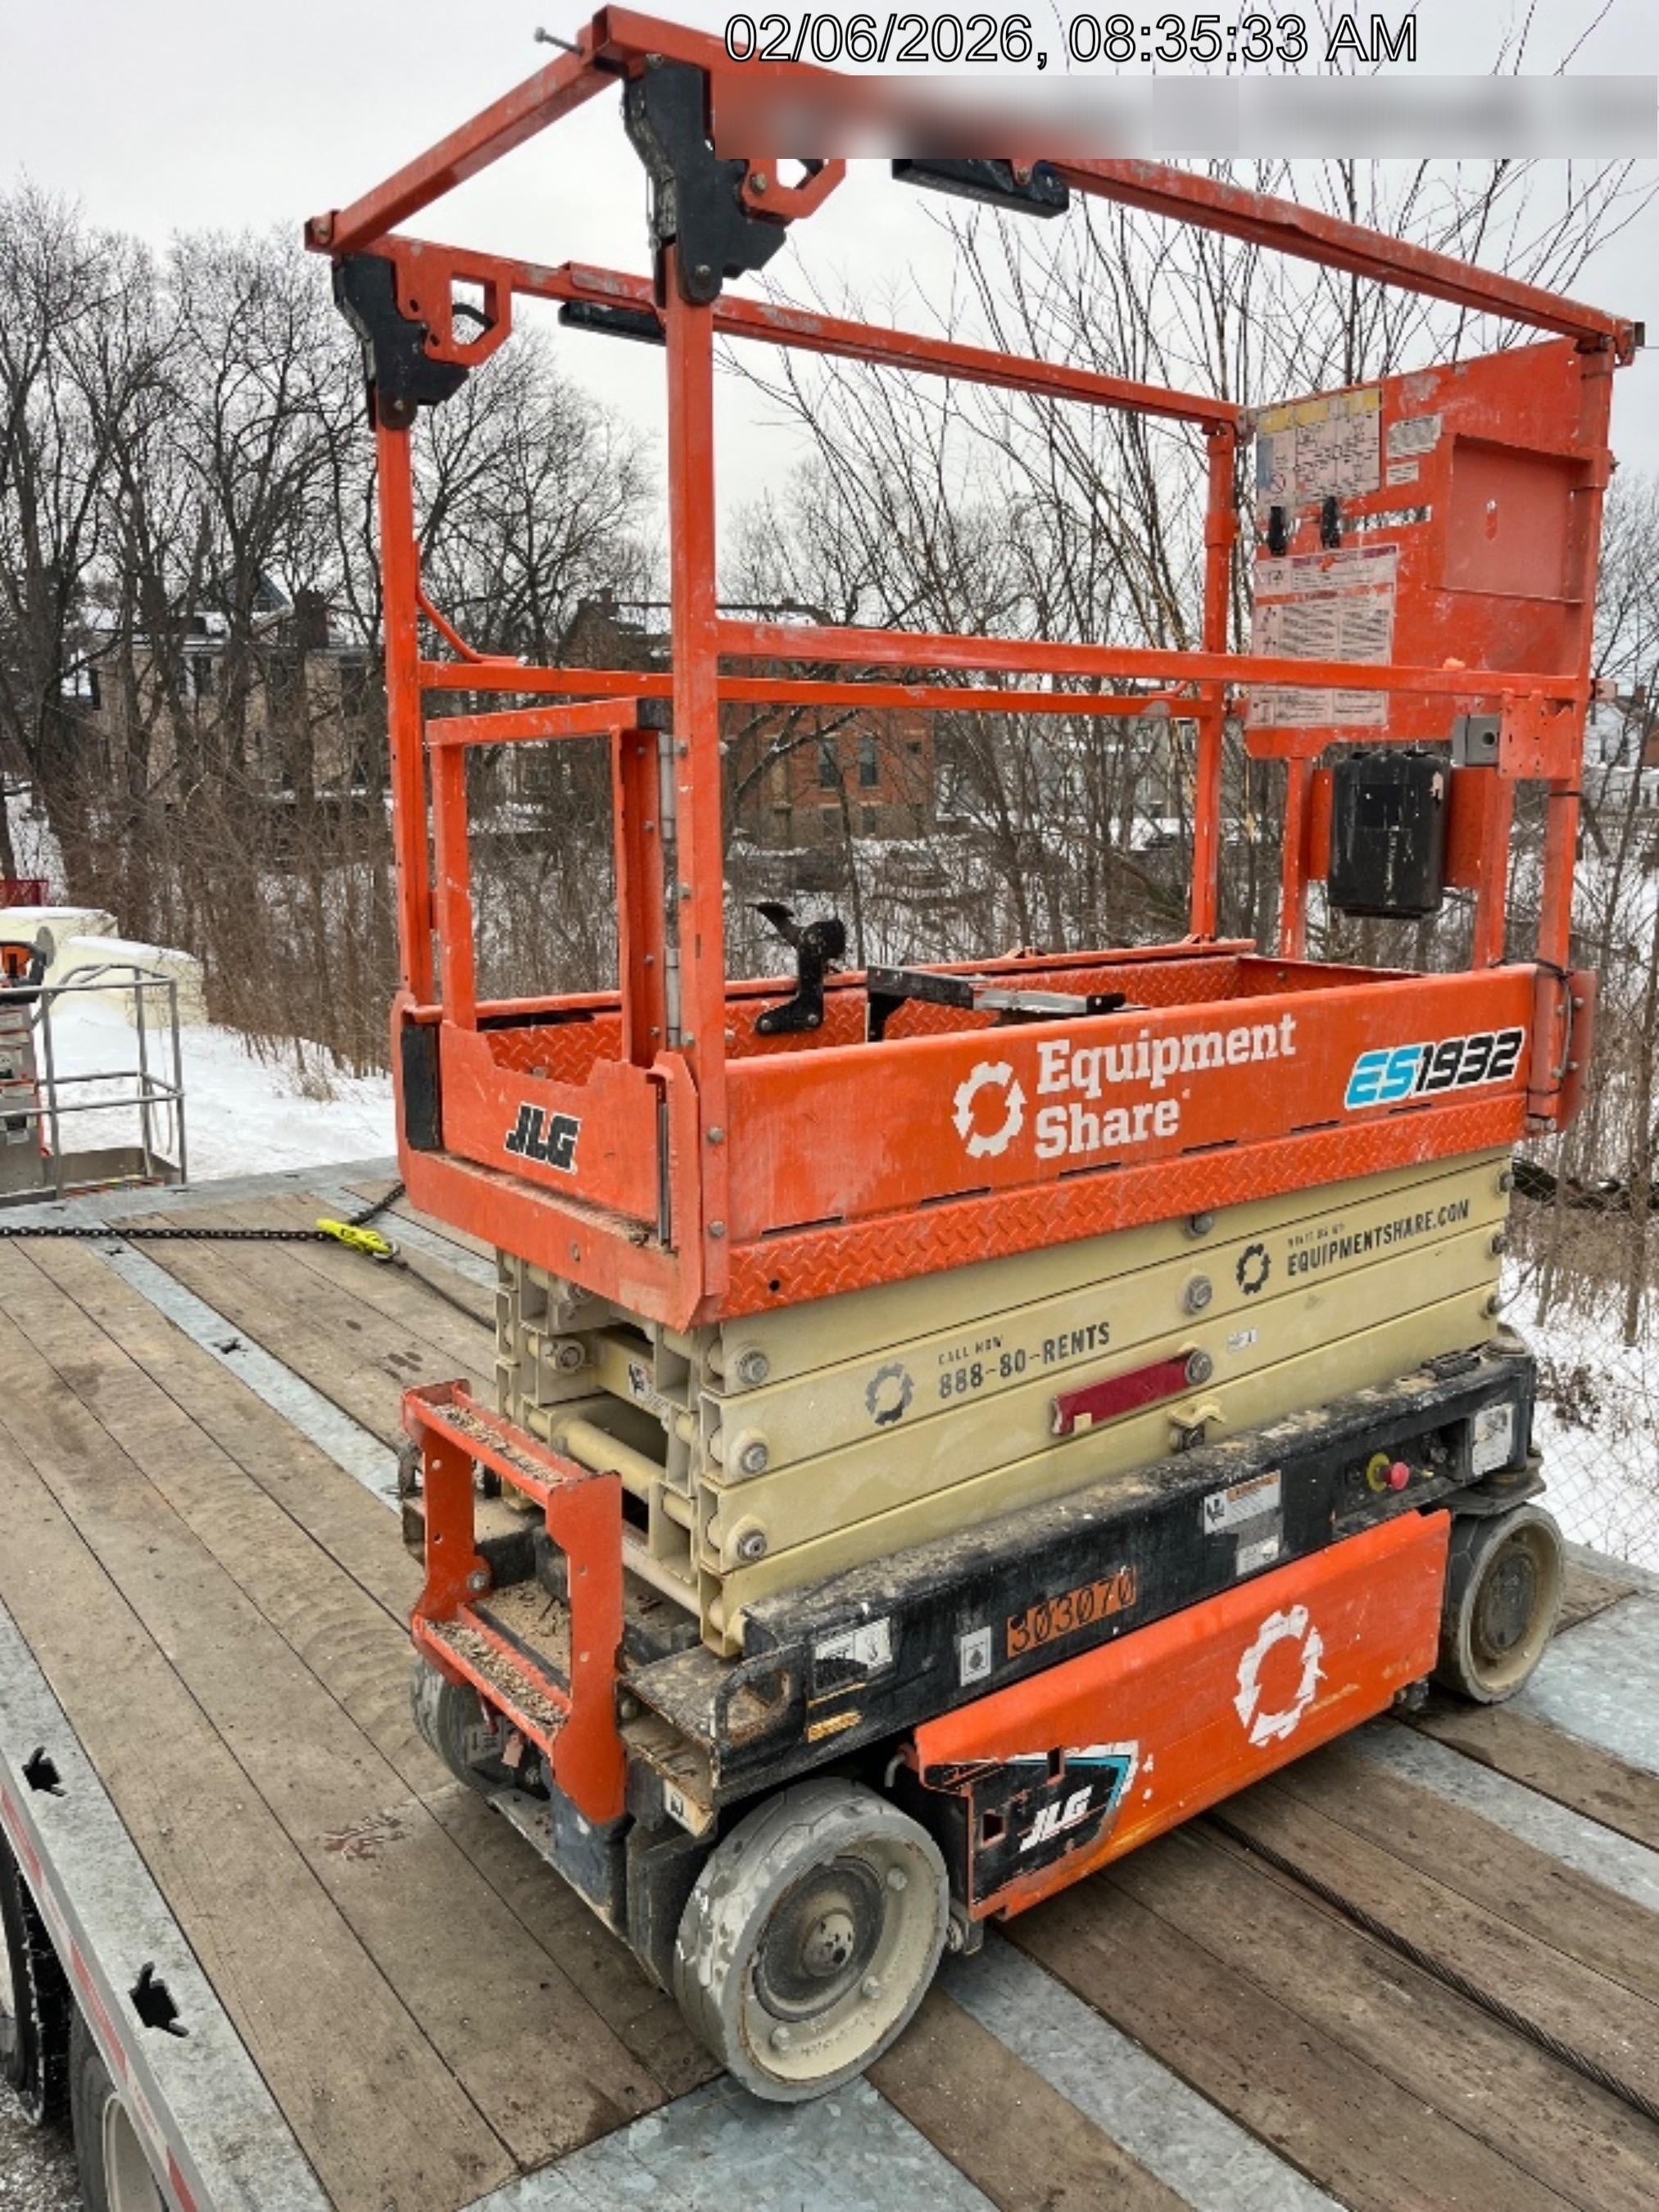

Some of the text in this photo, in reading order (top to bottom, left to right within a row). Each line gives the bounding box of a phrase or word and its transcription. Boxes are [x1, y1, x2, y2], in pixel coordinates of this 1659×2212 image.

[1037, 1013, 1297, 1099] Equipment
[1345, 1027, 1525, 1109] ES1932
[504, 1101, 582, 1175] JLG
[1034, 1098, 1180, 1158] Share
[938, 1321, 1110, 1399] 888-80-RENTS
[1009, 1566, 1135, 1652] 303070
[1019, 1785, 1093, 1852] JLG
